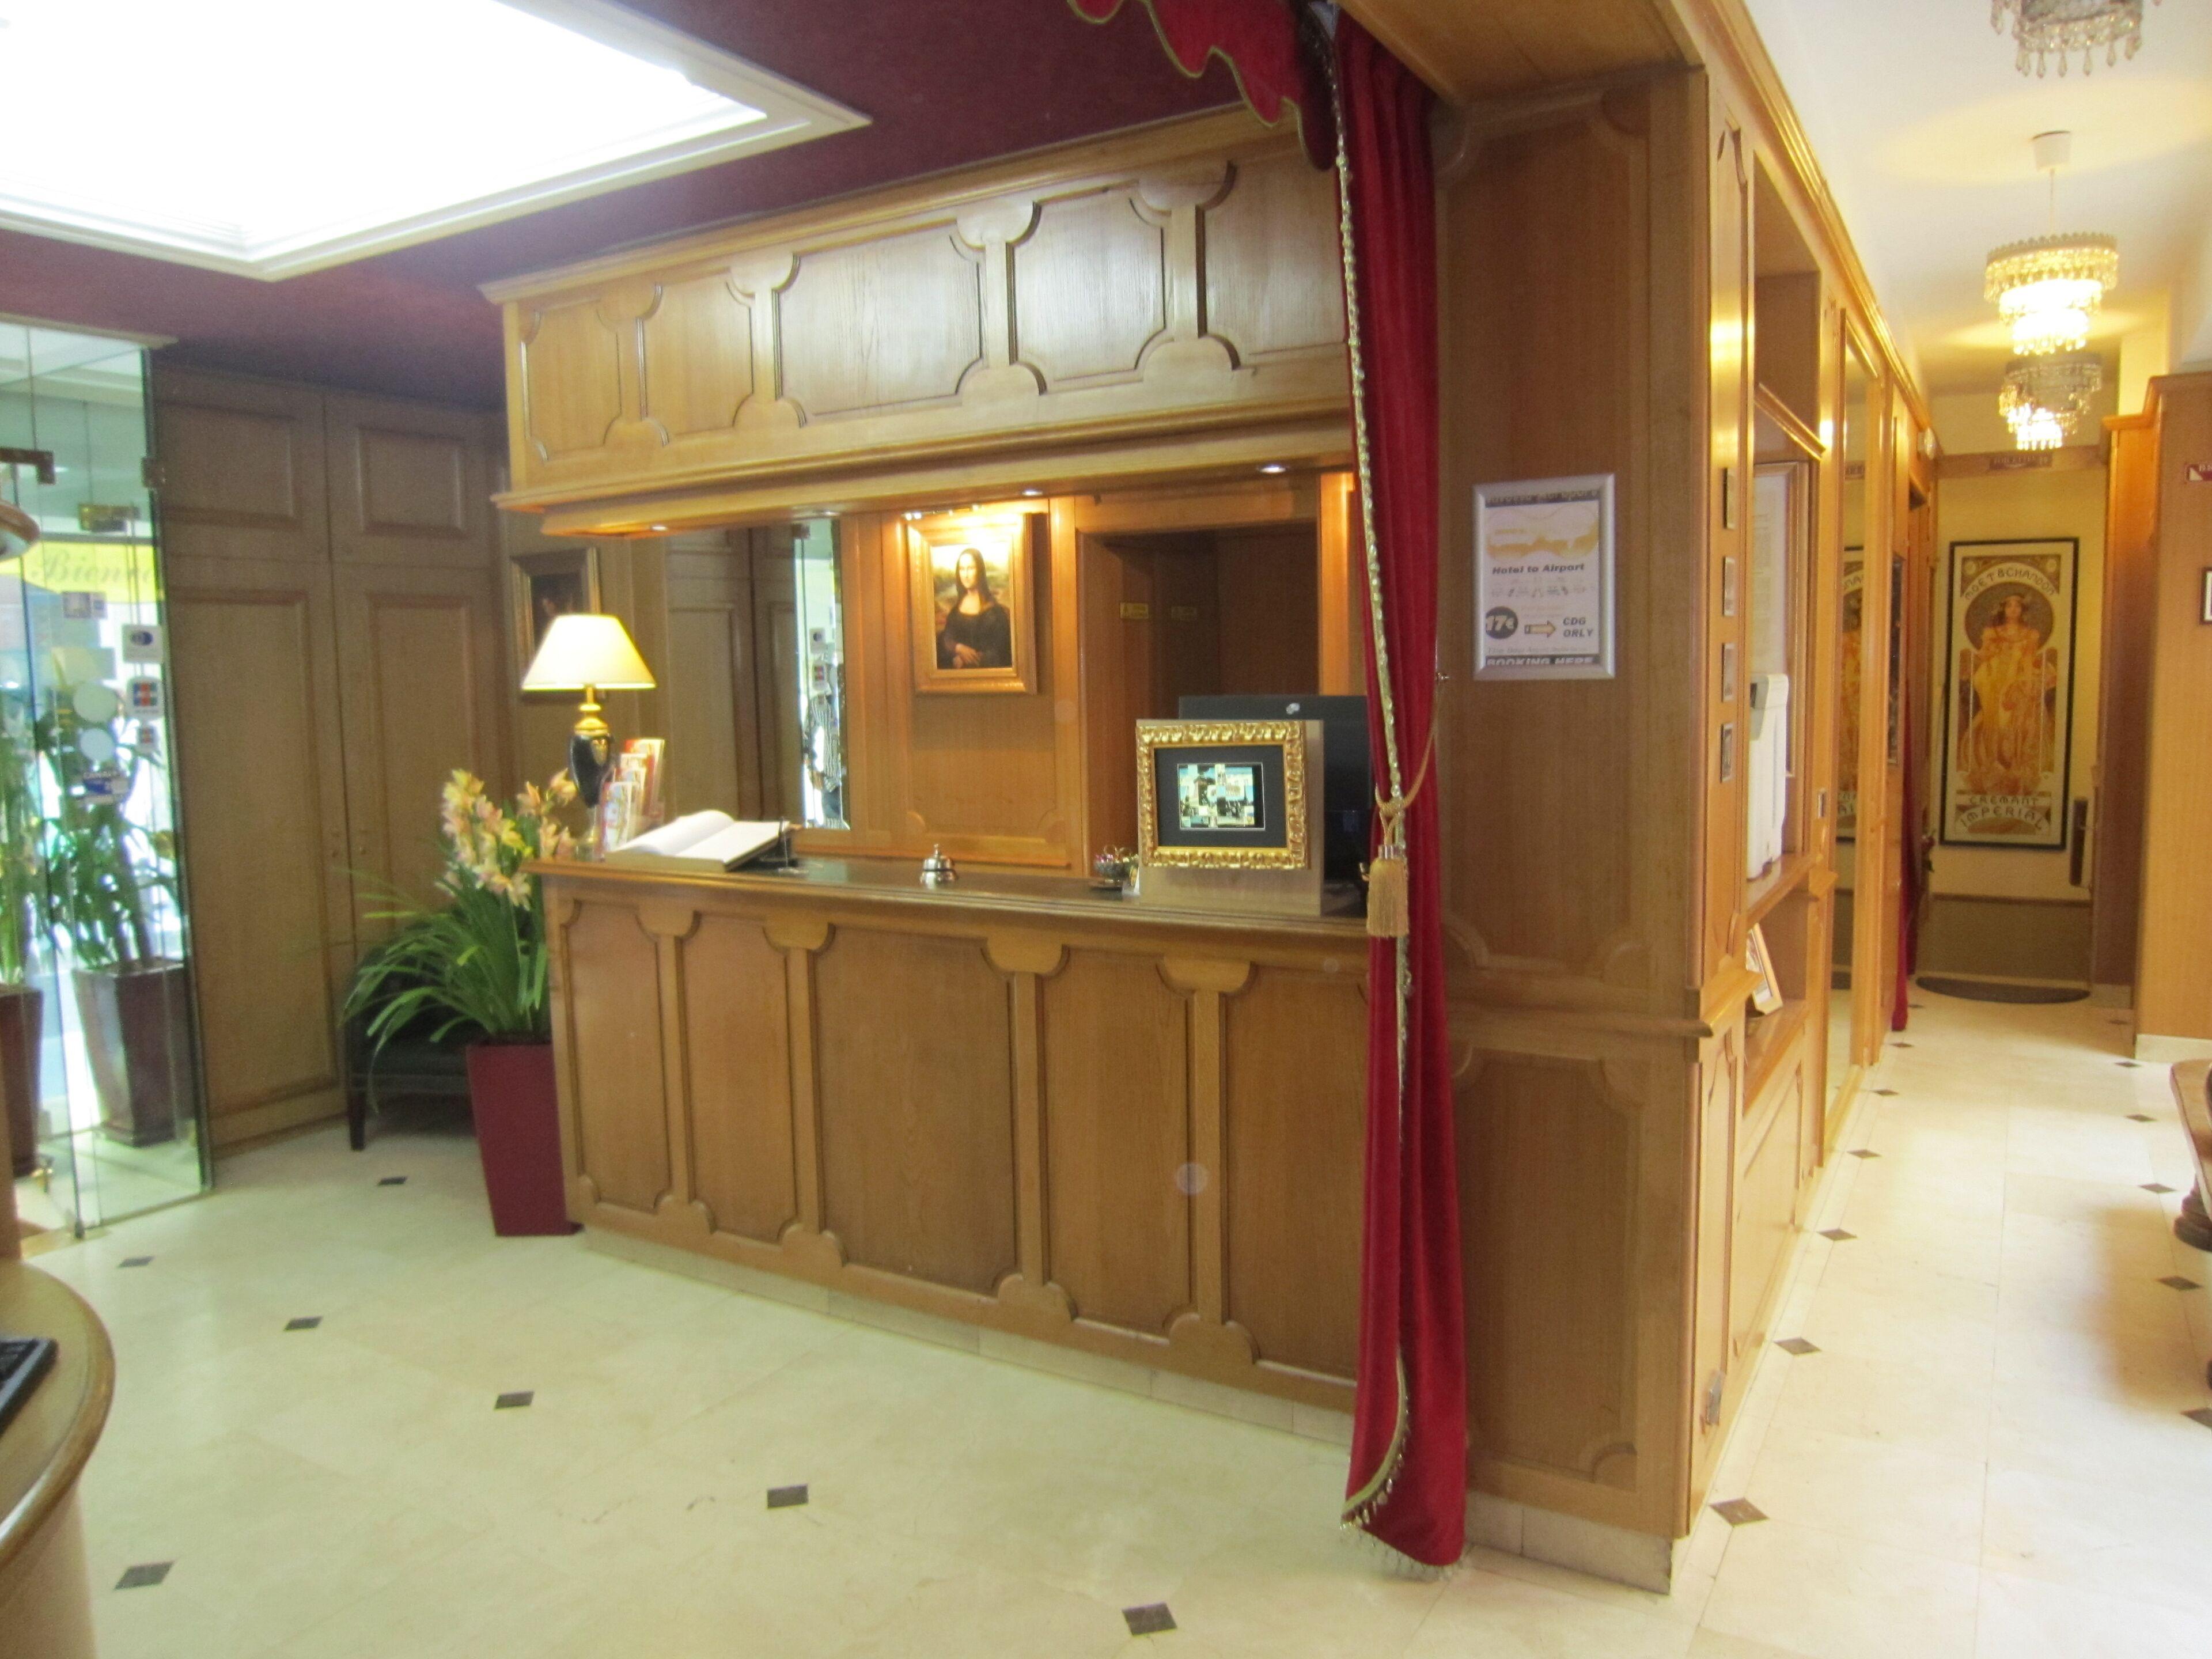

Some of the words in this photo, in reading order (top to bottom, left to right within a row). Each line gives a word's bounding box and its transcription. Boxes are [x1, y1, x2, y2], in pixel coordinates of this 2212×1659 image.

[1493, 565, 1524, 574] Hotel
[1543, 563, 1585, 573] Airport
[1563, 616, 1586, 626] CDG
[1563, 628, 1593, 638] ORLY
[1970, 796, 2039, 806] CREMANT
[1961, 806, 2044, 830] IMPERIAL
